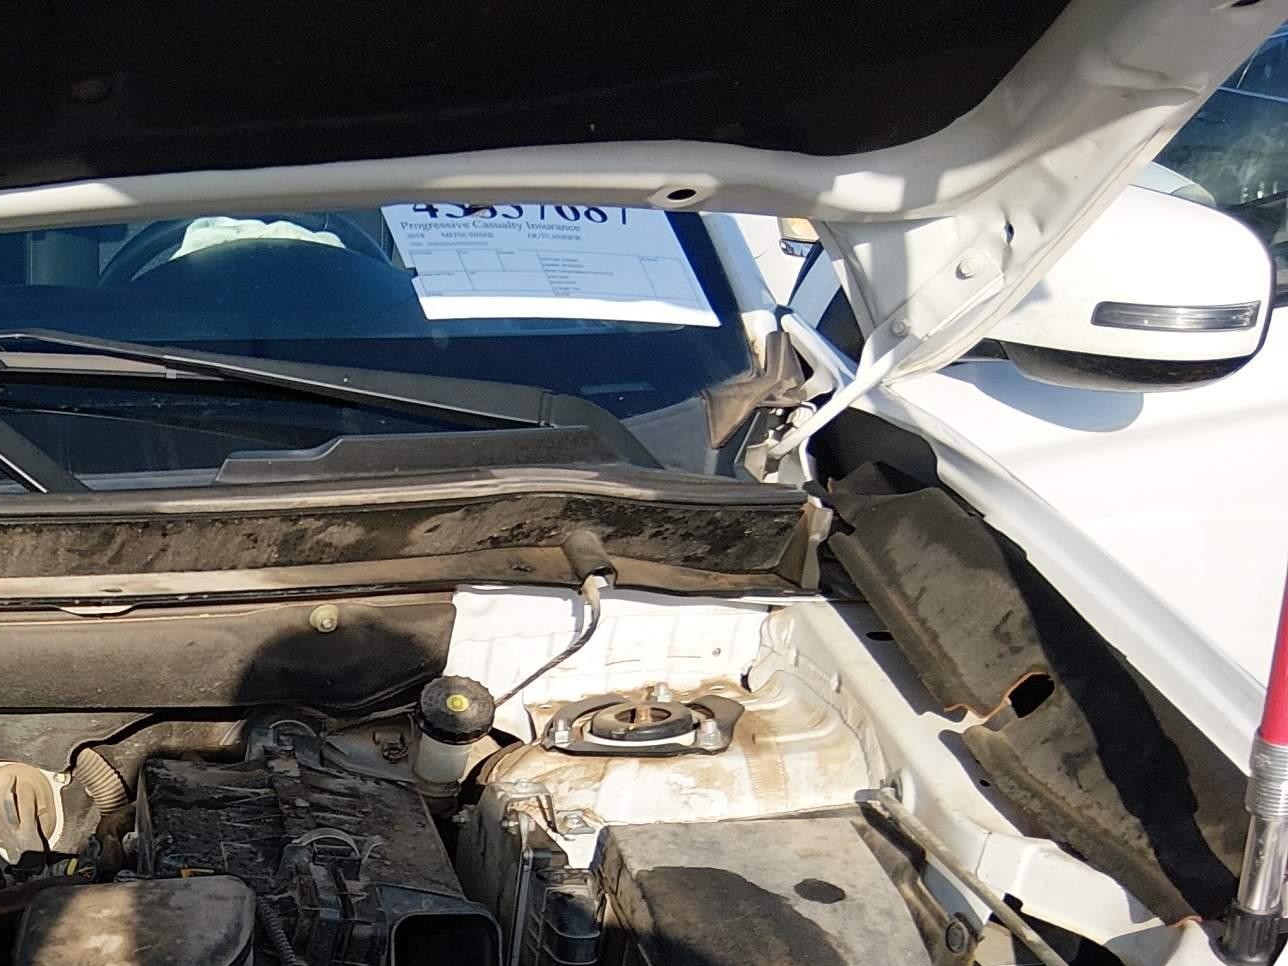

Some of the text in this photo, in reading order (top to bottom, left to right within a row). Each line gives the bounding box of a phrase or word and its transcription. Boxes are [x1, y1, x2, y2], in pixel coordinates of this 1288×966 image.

[400, 220, 582, 232] Progressive Casualty Insurance
